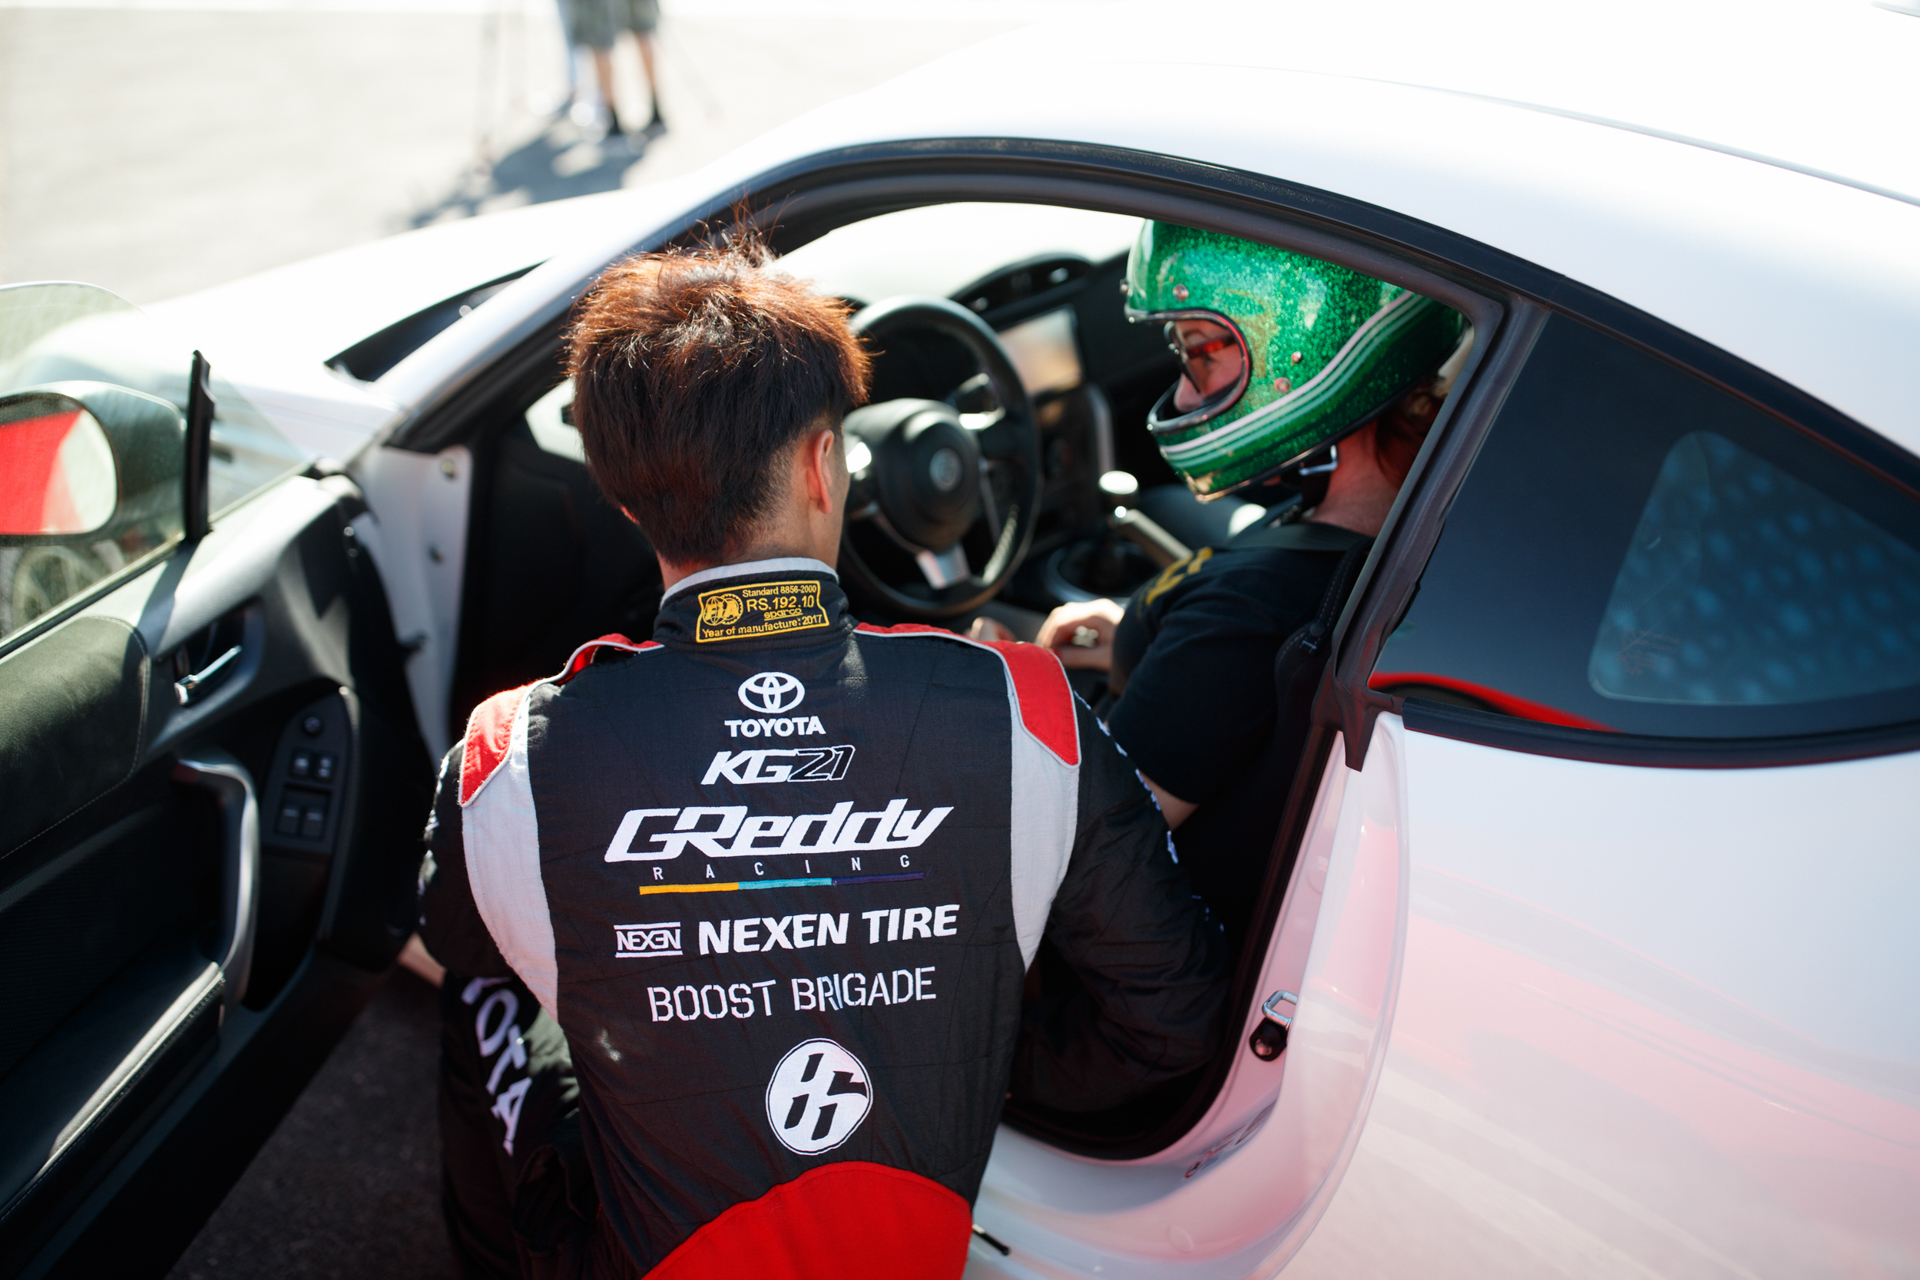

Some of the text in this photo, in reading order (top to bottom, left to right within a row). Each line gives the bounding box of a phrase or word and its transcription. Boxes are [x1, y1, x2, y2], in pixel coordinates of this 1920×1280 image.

[742, 585, 817, 599] Standard 8856-2000
[702, 628, 724, 639] Year
[725, 626, 736, 636] of
[802, 614, 822, 625] 2017
[763, 608, 802, 620] sparco
[724, 716, 826, 738] TOYOTA
[700, 744, 856, 785] KG21
[604, 798, 954, 863] GReddy
[615, 928, 681, 951] NEXEN
[699, 904, 960, 955] NEXEN TIRE
[646, 966, 937, 1022] BOOST BRIGADE
